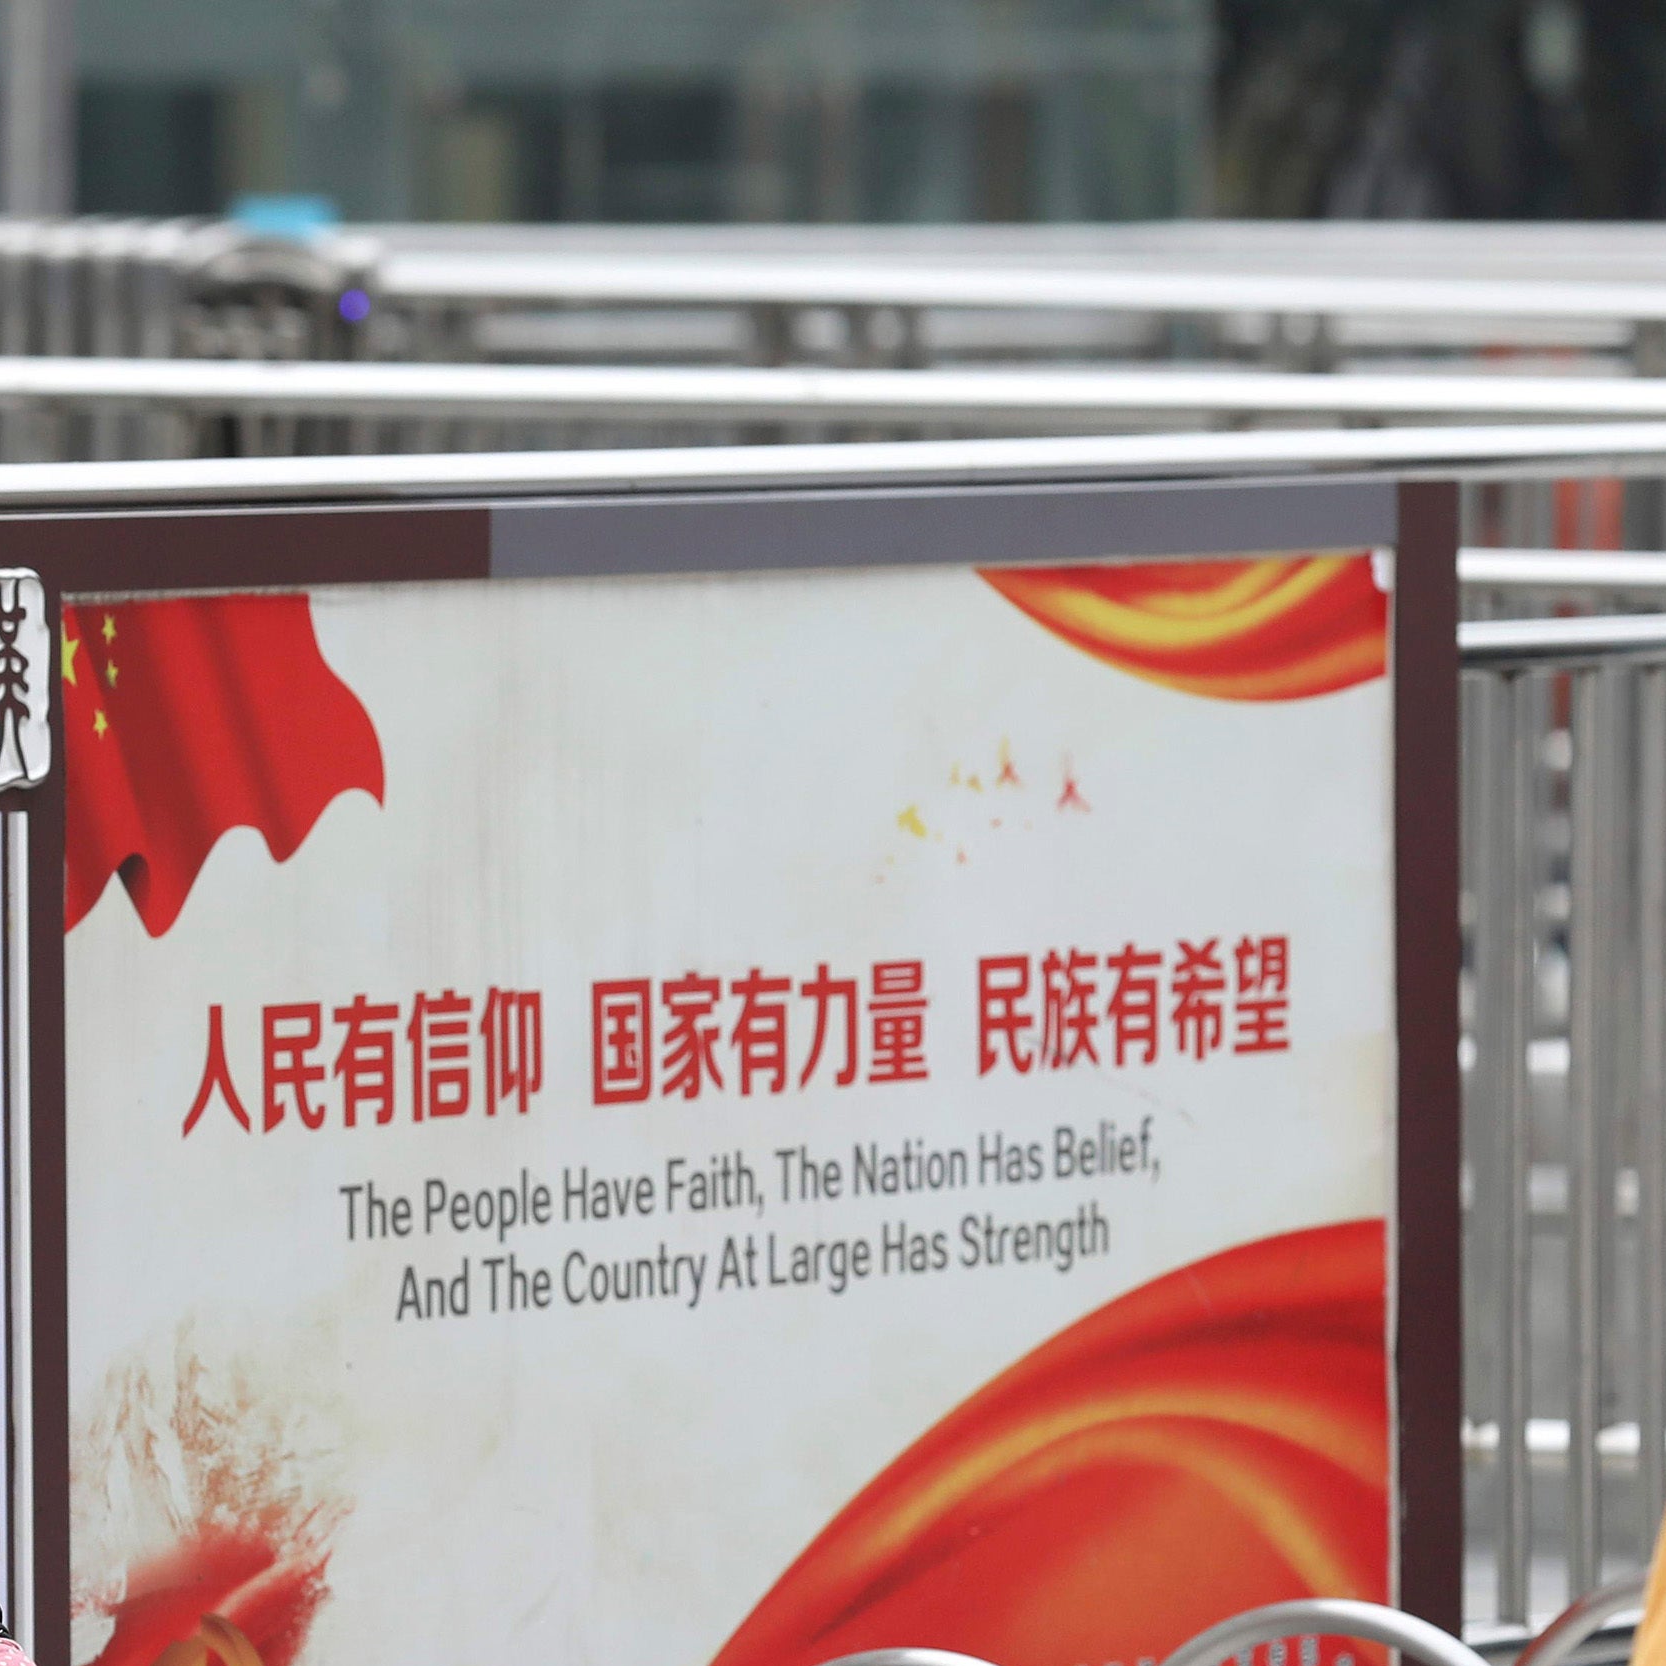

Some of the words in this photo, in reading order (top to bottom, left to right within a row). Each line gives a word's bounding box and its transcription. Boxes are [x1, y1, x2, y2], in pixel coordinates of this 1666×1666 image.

[182, 985, 544, 1139] 人民有信仰
[590, 957, 930, 1107] 国家有力量
[976, 933, 1292, 1079] 民族有希望
[339, 1179, 412, 1241] The
[424, 1167, 553, 1243] People
[562, 1165, 655, 1223] Have
[666, 1150, 766, 1218] Faith,
[775, 1144, 843, 1204] The
[852, 1138, 969, 1198] Nation
[977, 1130, 1044, 1185] Has
[1052, 1114, 1162, 1184] Belief,
[396, 1256, 470, 1323] And
[481, 1252, 553, 1314] The
[562, 1241, 708, 1310] Country
[717, 1232, 759, 1293] At
[767, 1230, 873, 1296] Large
[880, 1219, 950, 1276] Has
[959, 1199, 1111, 1273] Strength
